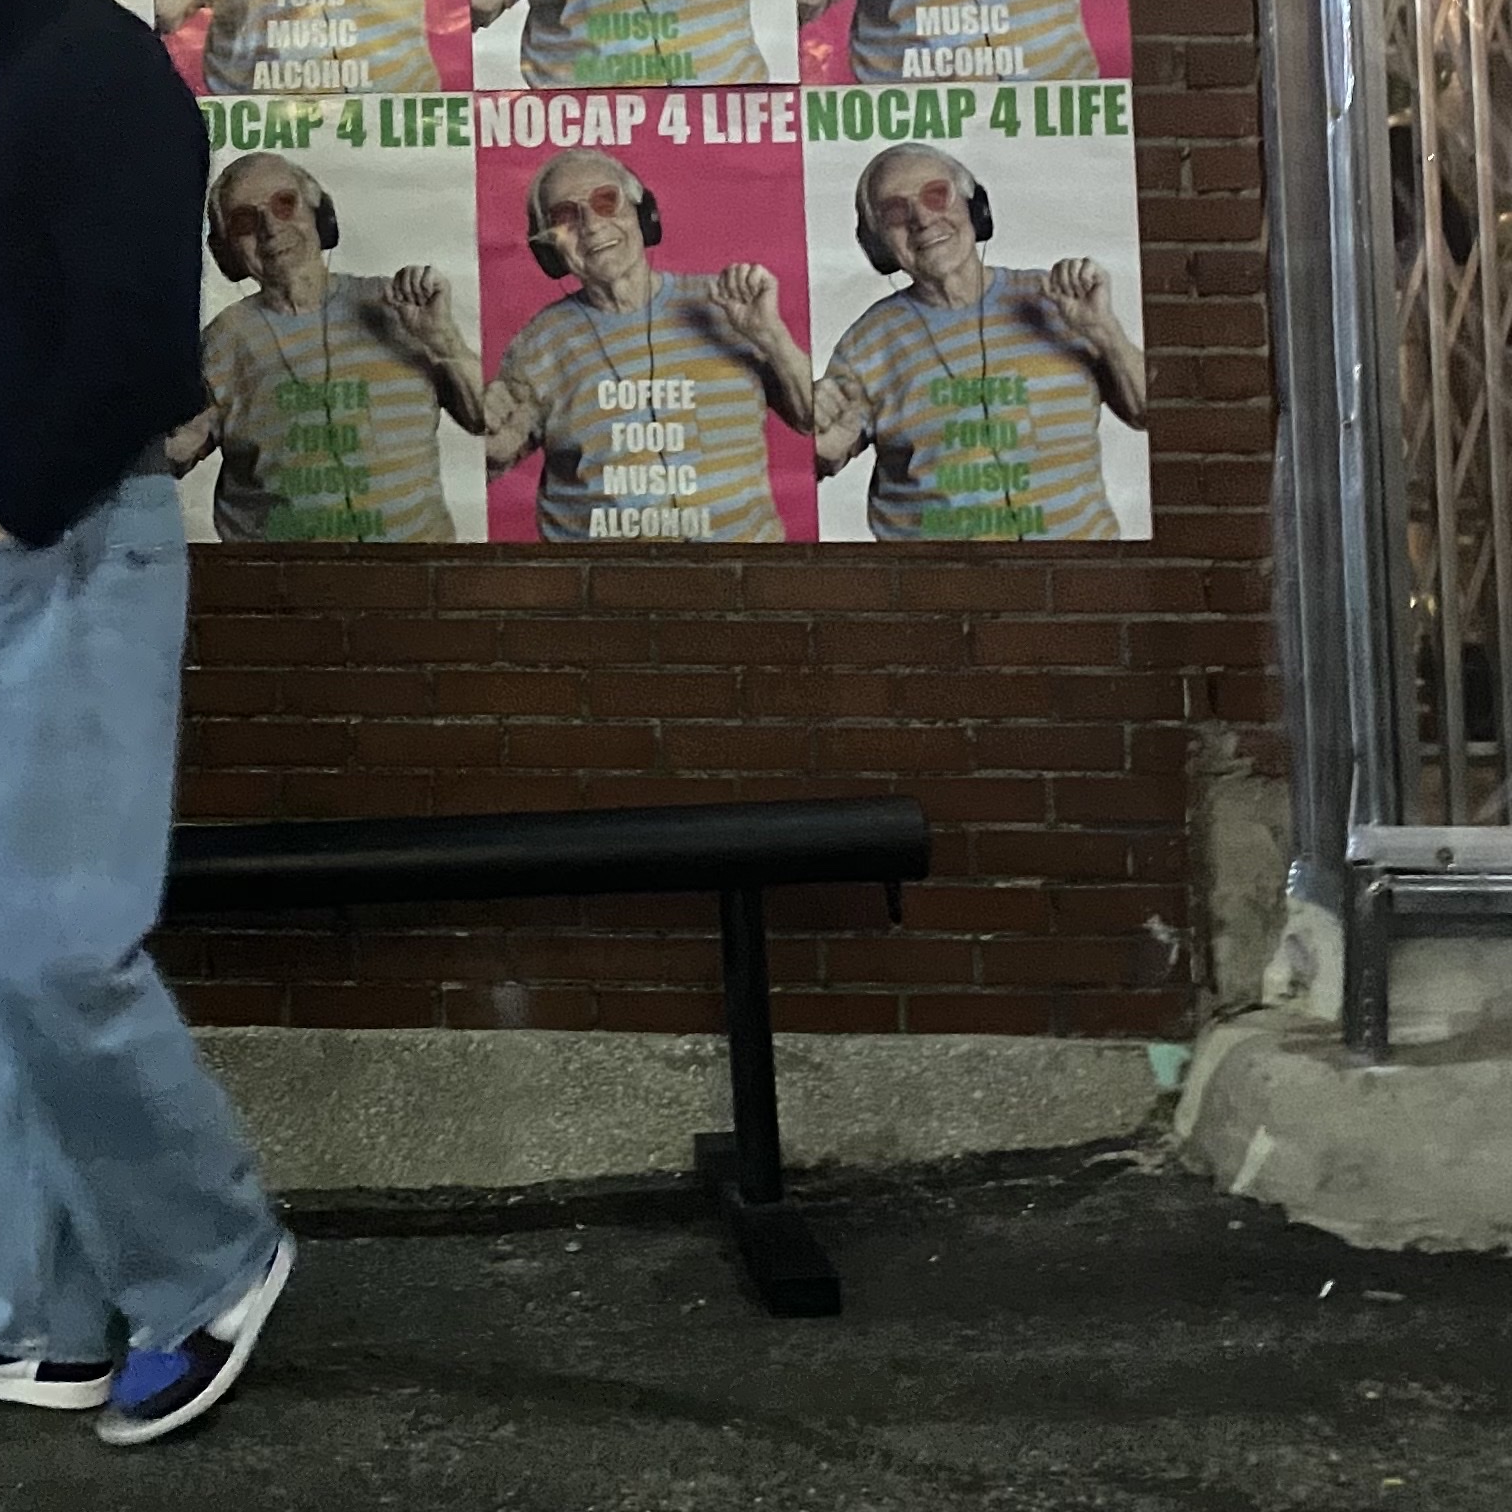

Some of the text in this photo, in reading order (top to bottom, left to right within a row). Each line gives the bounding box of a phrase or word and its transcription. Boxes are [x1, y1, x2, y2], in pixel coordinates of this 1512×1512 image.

[267, 20, 357, 49] MUSIC
[587, 11, 678, 43] MUSIC
[916, 5, 1010, 36] MUSIC
[253, 60, 372, 90] ALCOHOL
[903, 47, 1028, 78] ALCOHOL
[200, 97, 471, 151] OCAP 4 LIFE
[481, 91, 797, 148] NOCAP 4 LIFE
[808, 85, 1129, 141] NOCAP 4 LIFE
[598, 380, 696, 411] COFFEE
[611, 422, 685, 453] FOOD
[603, 465, 697, 496] MUSIC
[936, 462, 1031, 494] MUSIC
[589, 507, 714, 538] ALCOHOL
